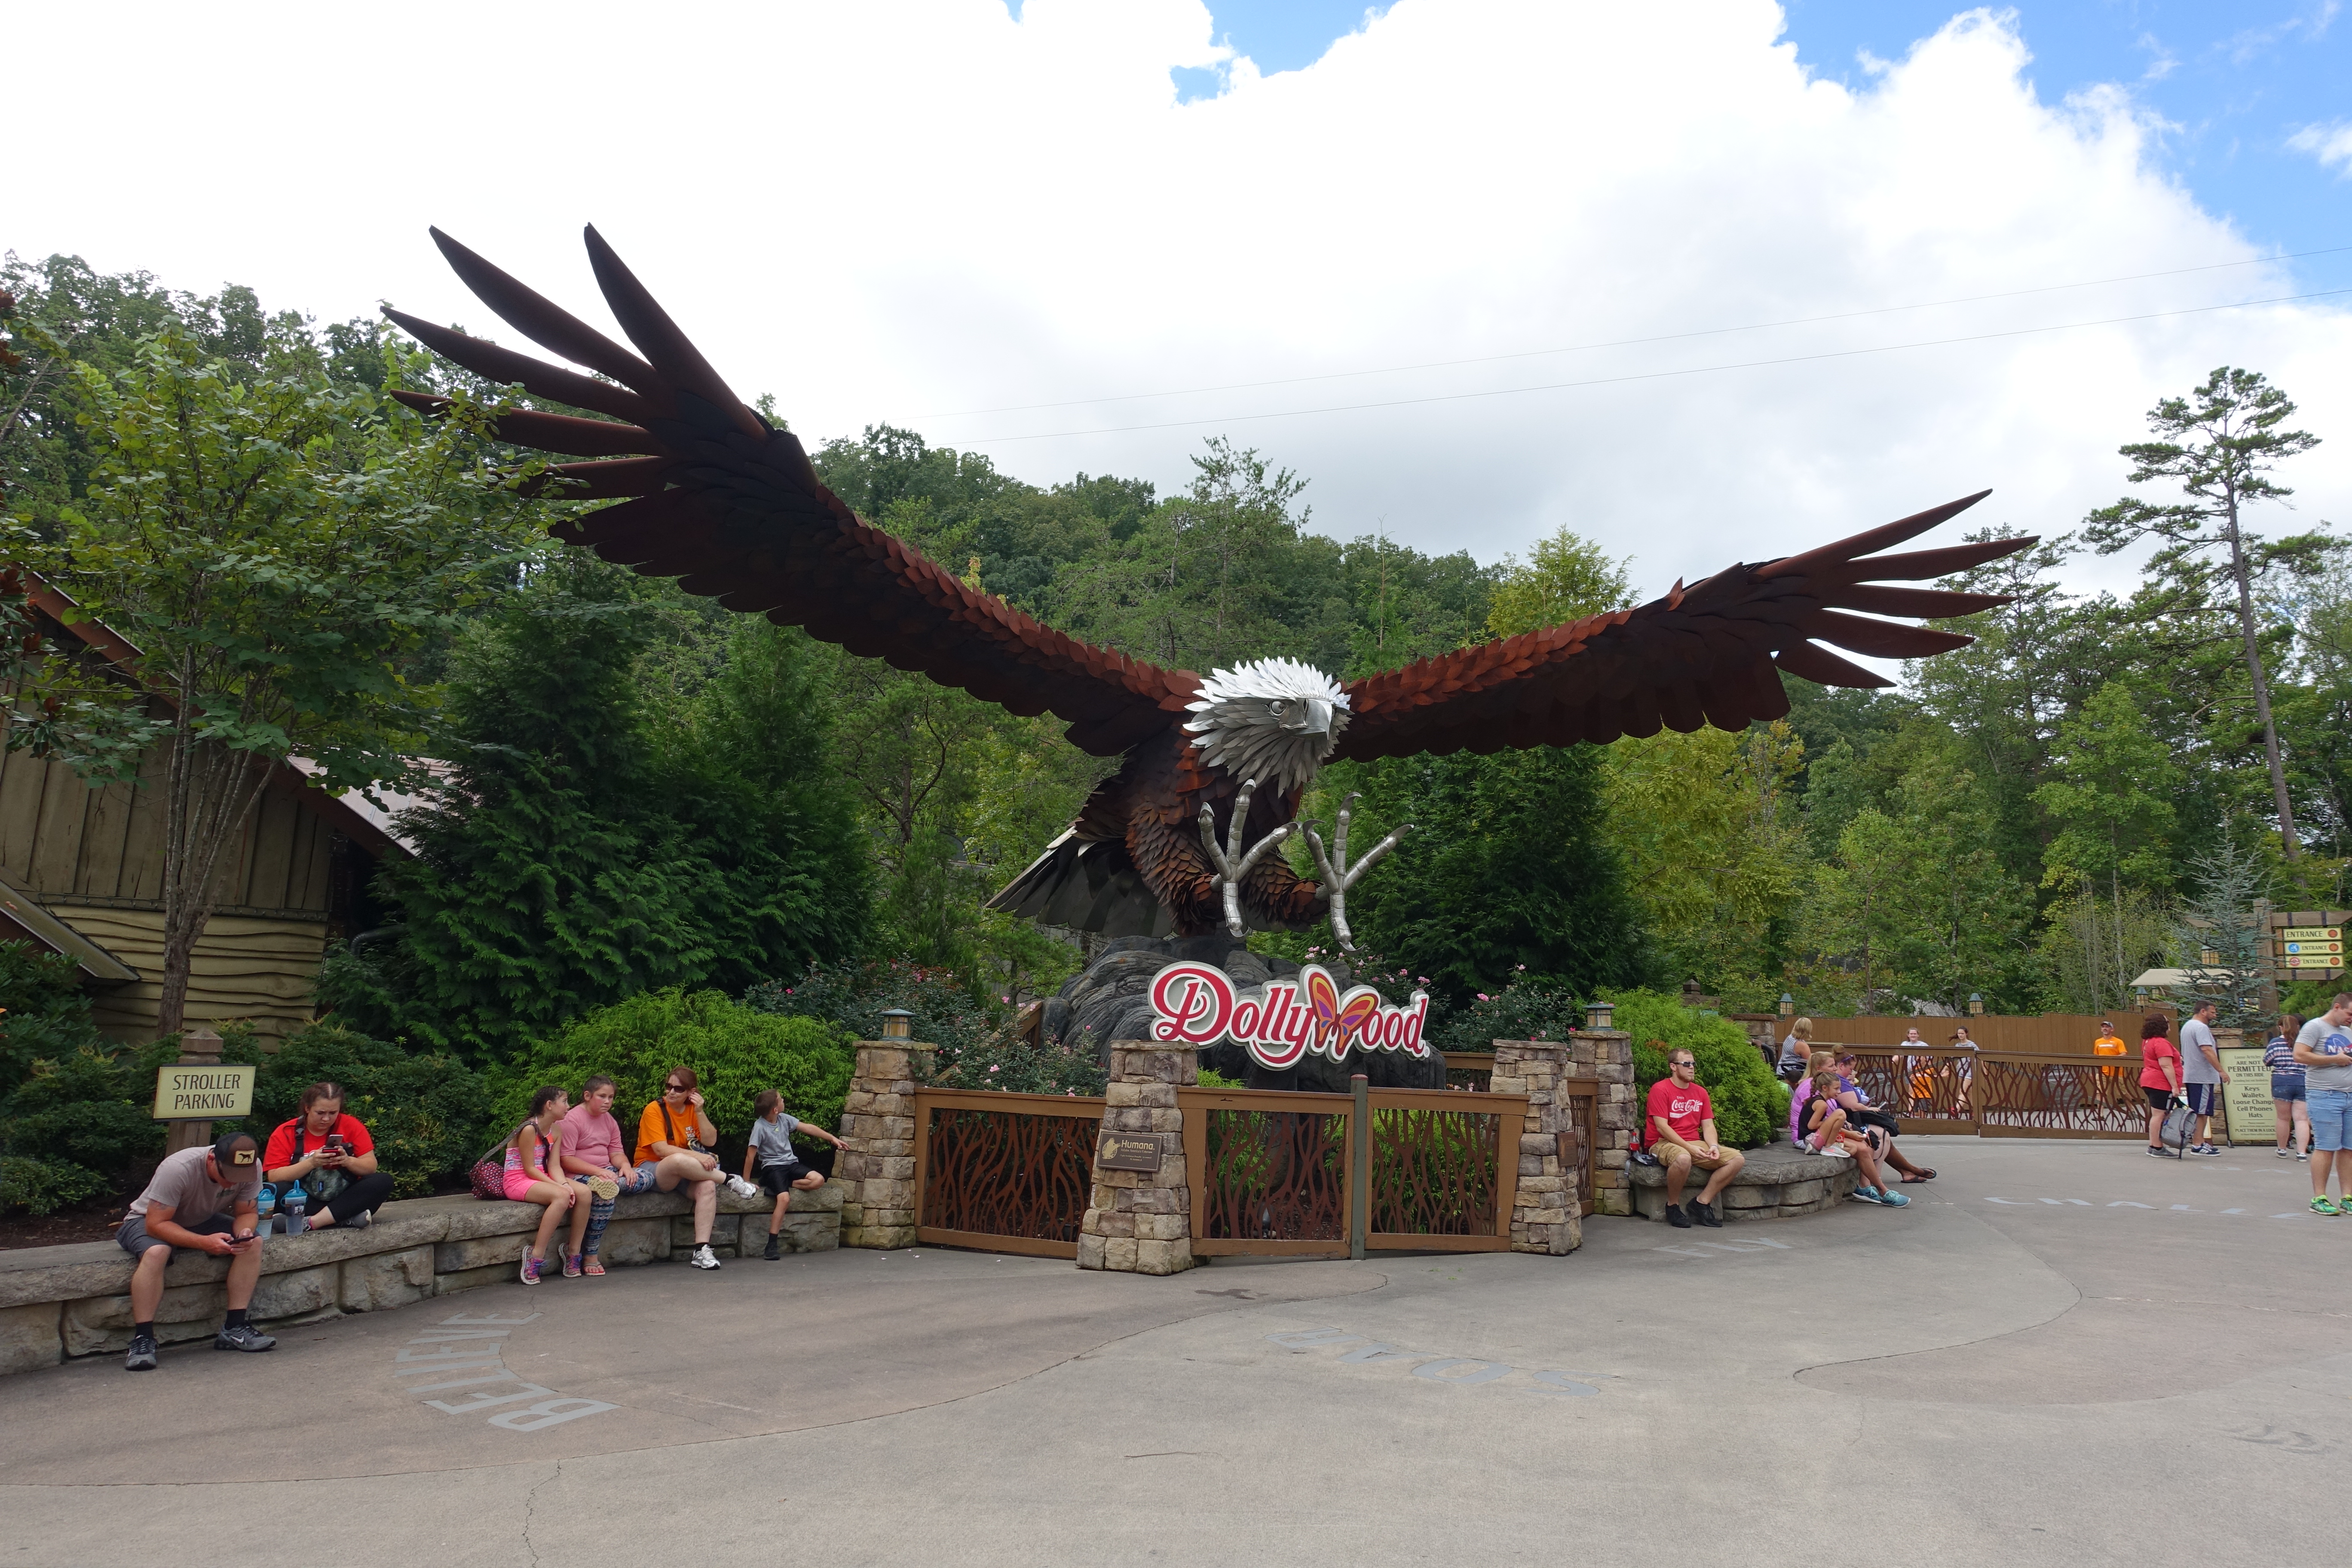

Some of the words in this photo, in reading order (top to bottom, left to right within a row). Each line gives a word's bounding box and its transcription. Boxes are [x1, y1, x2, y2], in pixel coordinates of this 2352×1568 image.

[2328, 1045, 2352, 1053] NAS
[172, 1074, 241, 1090] STROLLER
[174, 1093, 235, 1110] PARKING
[1263, 1326, 1621, 1396] SOAR
[394, 1312, 622, 1432] BELIEVE
